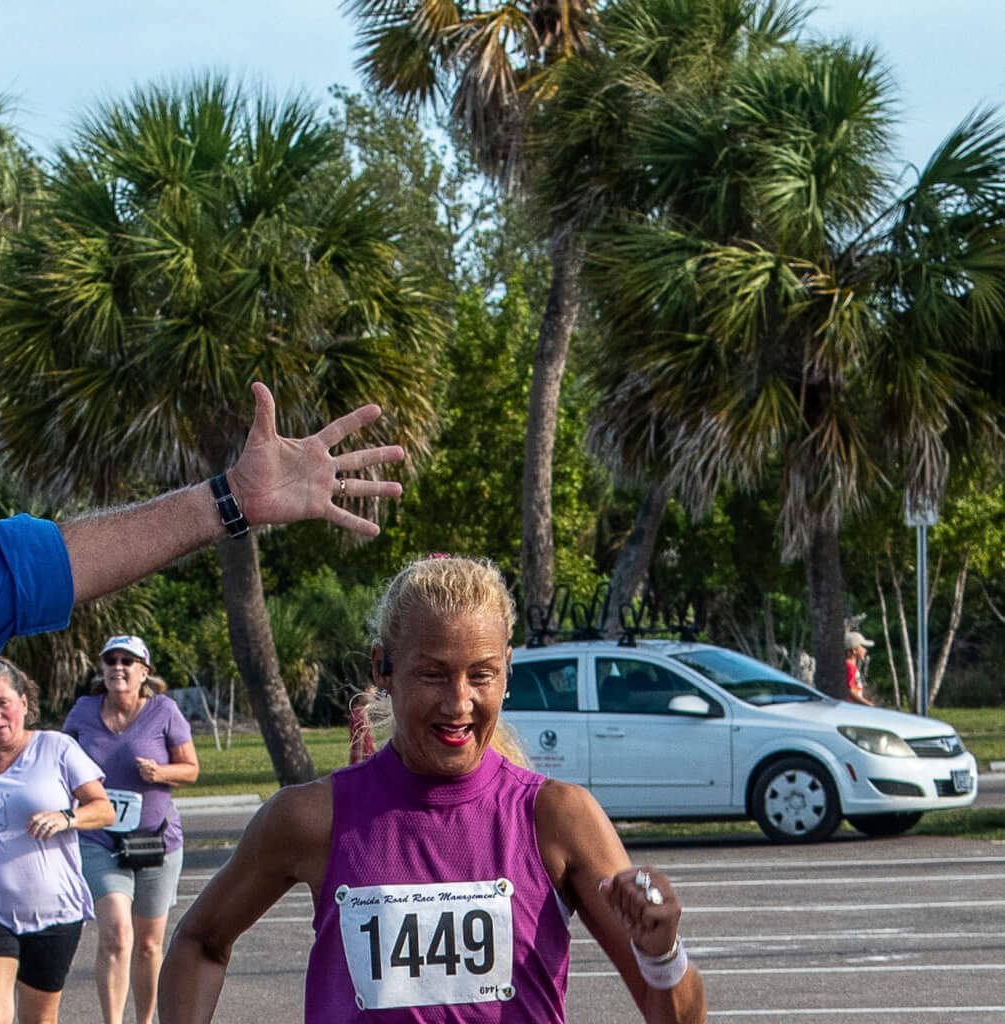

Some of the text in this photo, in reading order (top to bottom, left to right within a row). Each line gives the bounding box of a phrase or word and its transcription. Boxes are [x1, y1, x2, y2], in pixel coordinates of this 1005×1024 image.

[350, 890, 498, 908] Florida Road Race Management
[360, 909, 495, 980] 1449
